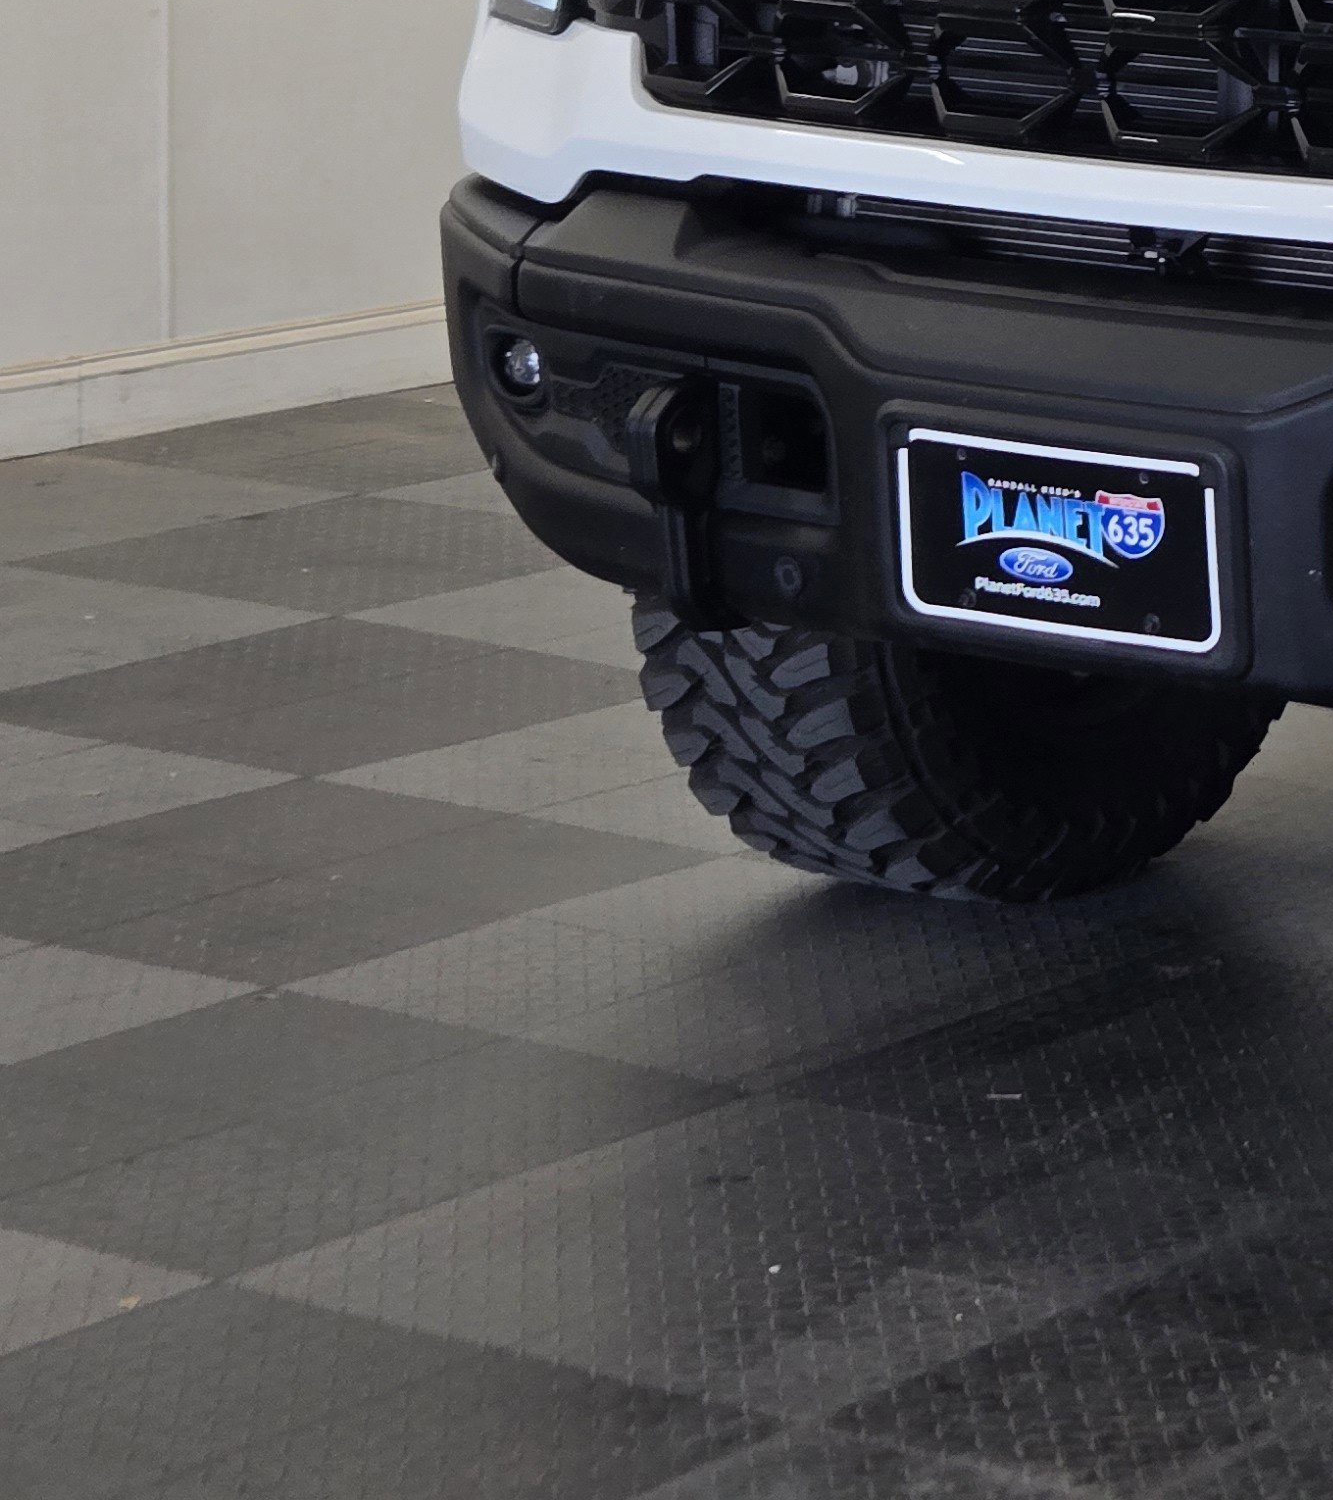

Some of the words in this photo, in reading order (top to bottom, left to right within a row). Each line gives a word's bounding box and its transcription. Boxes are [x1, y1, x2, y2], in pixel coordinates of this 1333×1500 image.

[961, 471, 1106, 557] PLANET
[1108, 514, 1155, 548] 635
[1013, 552, 1060, 578] Ford
